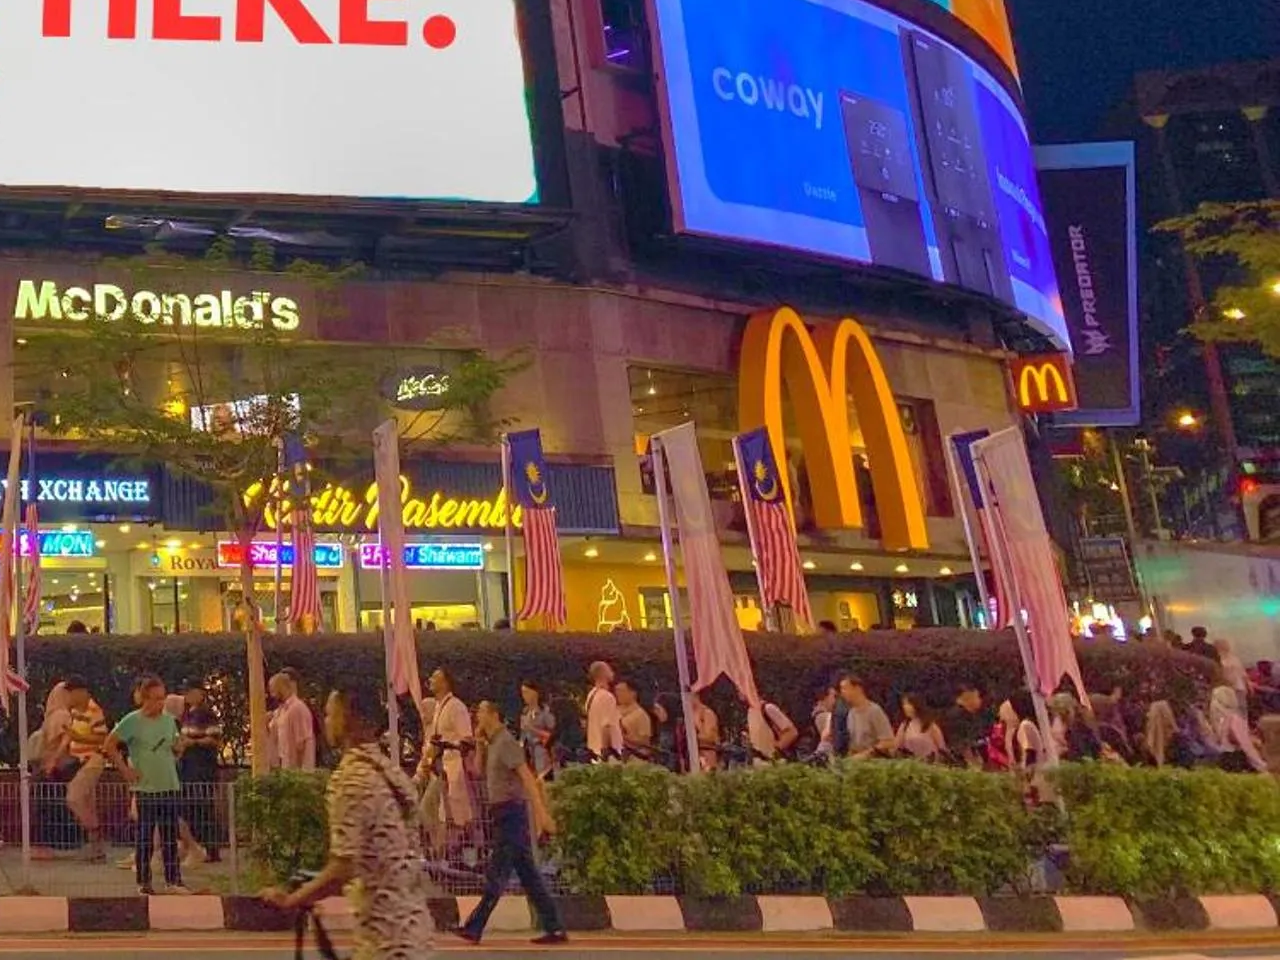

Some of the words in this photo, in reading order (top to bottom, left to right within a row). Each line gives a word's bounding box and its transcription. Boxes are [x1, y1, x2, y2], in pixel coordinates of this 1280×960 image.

[711, 66, 824, 130] coway
[14, 279, 301, 333] McDonald's
[1070, 225, 1099, 330] PREDATOR
[170, 554, 219, 571] ROYA
